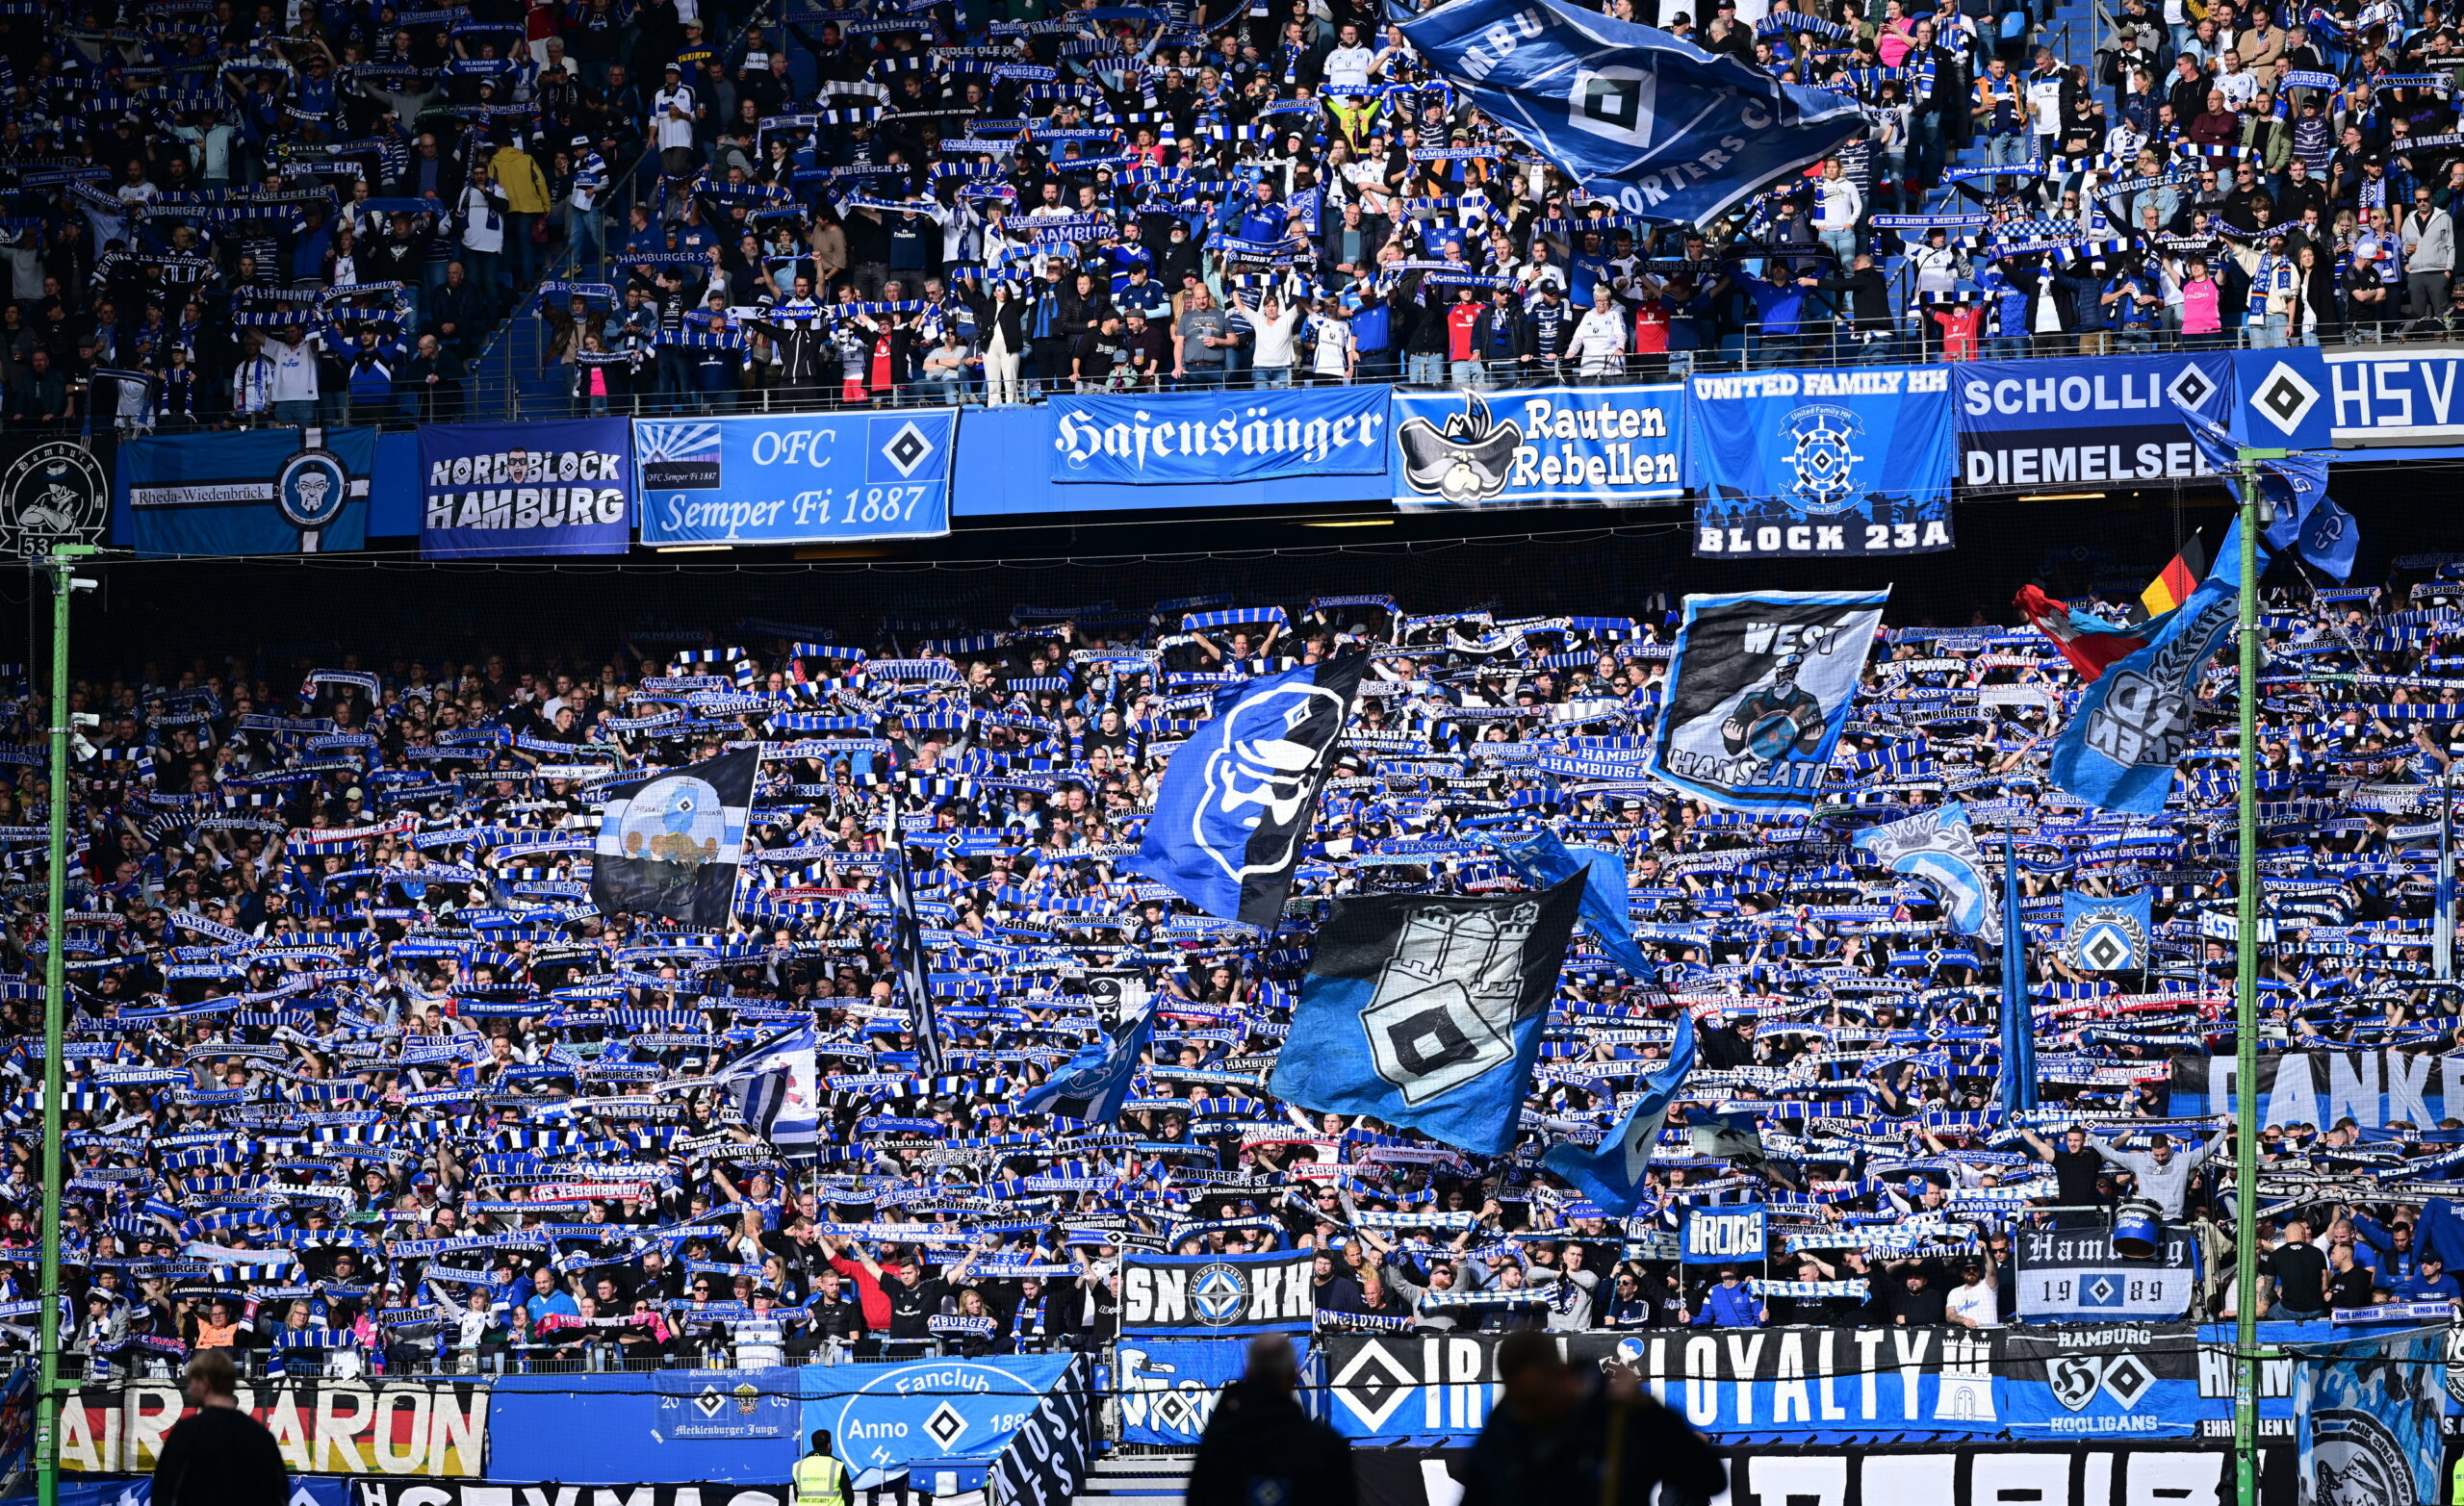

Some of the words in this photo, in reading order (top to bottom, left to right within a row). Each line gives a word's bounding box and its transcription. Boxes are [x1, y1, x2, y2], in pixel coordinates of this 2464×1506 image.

[1032, 129, 1095, 139] HAMBURGER
[1096, 128, 1113, 138] SV
[2416, 134, 2462, 146] IMMER
[1415, 147, 1479, 160] HAMBURGER
[334, 163, 359, 173] ELBE
[2095, 174, 2173, 201] HAMBURGER
[2176, 171, 2194, 184] SV
[1004, 216, 1069, 228] HAMBURGER
[1072, 214, 1091, 223] S.V.
[1880, 217, 1893, 225] 25
[1933, 217, 1964, 225] MEIN
[1965, 216, 1990, 224] HSV
[2002, 239, 2070, 255] HAMBURGER
[2073, 237, 2089, 247] SV
[2168, 241, 2208, 250] STADION
[620, 253, 694, 264] HAMBURGER
[1431, 274, 1471, 286] SCHEISS
[1475, 276, 1486, 286] ST
[1693, 372, 1800, 400] UNITED
[1802, 370, 1904, 396] FAMILY
[1906, 369, 1949, 394] HH
[1964, 372, 2160, 416] SCHOLLI
[2331, 360, 2457, 427] HSV
[1525, 398, 1667, 442] Rauten
[1791, 406, 1815, 421] United
[1815, 406, 1840, 418] Family
[1840, 410, 1852, 420] HH
[1055, 406, 1383, 472] Hafensänger
[752, 428, 836, 468] OFC
[17, 445, 94, 473] Hamburg
[527, 449, 622, 483] BLOCK
[1511, 442, 1679, 488] Rebellen
[664, 472, 689, 484] Semper
[139, 485, 265, 504] Rheda-Wiedenbrück
[426, 487, 625, 530] HAMBURG
[661, 492, 785, 539] Semper
[791, 488, 833, 526] Fi
[844, 485, 926, 523] 1887
[1699, 525, 1844, 553] BLOCK
[1864, 521, 1950, 549] 23A
[1744, 622, 1847, 656] WEST
[2276, 638, 2348, 652] HAMBURGER
[646, 678, 703, 689] HAMBURGER
[1907, 709, 1978, 724] HAMBURGER
[1983, 707, 1998, 718] SV
[407, 748, 467, 758] HAMBURGER
[1551, 761, 1635, 777] HAMBURG
[583, 771, 648, 789] HAMBURGER
[1447, 779, 1490, 788] STADION
[412, 788, 452, 801] Pokalsieger
[970, 848, 1005, 856] STADION
[2158, 846, 2175, 856] SV
[564, 906, 597, 917] NUR
[1811, 905, 1890, 914] HAMBURG
[1015, 959, 1076, 974] HAMBURG
[570, 987, 614, 998] MOIN
[634, 1035, 701, 1045] HAMBURGER
[110, 1070, 174, 1084] HAMBURG
[504, 1066, 526, 1076] Herz
[833, 1074, 907, 1085] HAMBURG
[1184, 1072, 1255, 1085] KRAWALLBRAUSE
[175, 1091, 240, 1104] HAMBURGER
[243, 1087, 258, 1098] SV
[243, 1116, 263, 1126] WEG
[878, 1117, 912, 1126] Hanwha
[915, 1118, 937, 1129] Solar
[2025, 1110, 2132, 1122] CASTAWAYS
[153, 1134, 234, 1148] HAMBURGER
[678, 1138, 721, 1151] STADION
[1373, 1150, 1391, 1159] ALLE
[1392, 1151, 1414, 1160] MANN
[1415, 1152, 1430, 1161] AUF
[908, 1201, 989, 1212] HAMBURGER
[992, 1204, 1011, 1215] SV
[836, 1224, 869, 1233] TEAM
[870, 1223, 928, 1233] NORDHEIDE
[446, 1237, 475, 1249] Nur
[477, 1233, 501, 1245] der
[506, 1231, 539, 1242] HSV
[867, 1232, 899, 1240] TEAM
[901, 1233, 965, 1241] NORDHEIDE
[1913, 1242, 1970, 1259] LOYALTY
[134, 1264, 208, 1276] HAMBURGER
[980, 1266, 1010, 1275] TEAM
[1012, 1264, 1069, 1274] NORDHEIDE
[1125, 1266, 1186, 1323] SN
[1247, 1264, 1313, 1321] HH
[2042, 1280, 2071, 1302] 19
[2130, 1279, 2162, 1302] 89
[707, 1312, 738, 1321] United
[771, 1308, 802, 1319] Family
[2351, 1309, 2379, 1319] IMMER
[2413, 1305, 2432, 1315] UND
[1351, 1315, 1407, 1332] LOYALTY
[2058, 1327, 2151, 1347] HAMBURG
[895, 1368, 990, 1400] Fanclub
[1649, 1328, 1931, 1428] LOYALTY
[661, 1395, 680, 1410] 20
[59, 1378, 185, 1472] AIR
[675, 1423, 744, 1437] Mecklenburger
[747, 1423, 778, 1437] Jungs
[848, 1418, 909, 1441] Anno
[2050, 1415, 2158, 1433] HOOLIGANS
